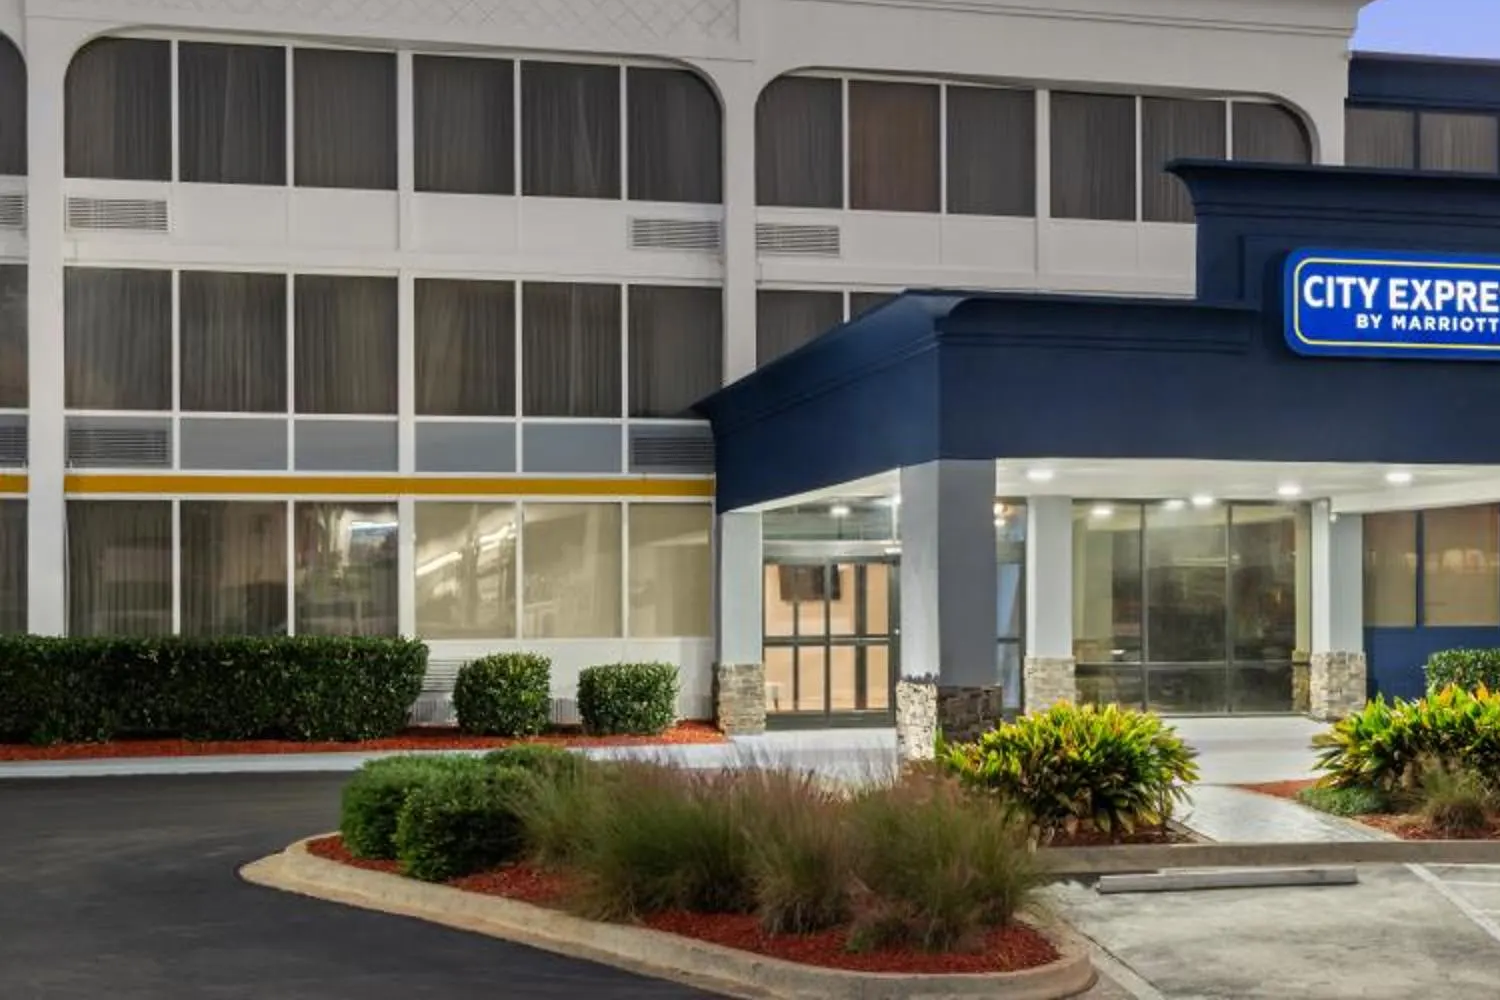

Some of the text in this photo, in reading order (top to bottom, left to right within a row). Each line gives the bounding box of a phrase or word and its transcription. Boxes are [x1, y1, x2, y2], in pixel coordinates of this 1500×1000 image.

[1303, 275, 1380, 309] CITY
[1356, 313, 1499, 333] BY MARRIOTT
